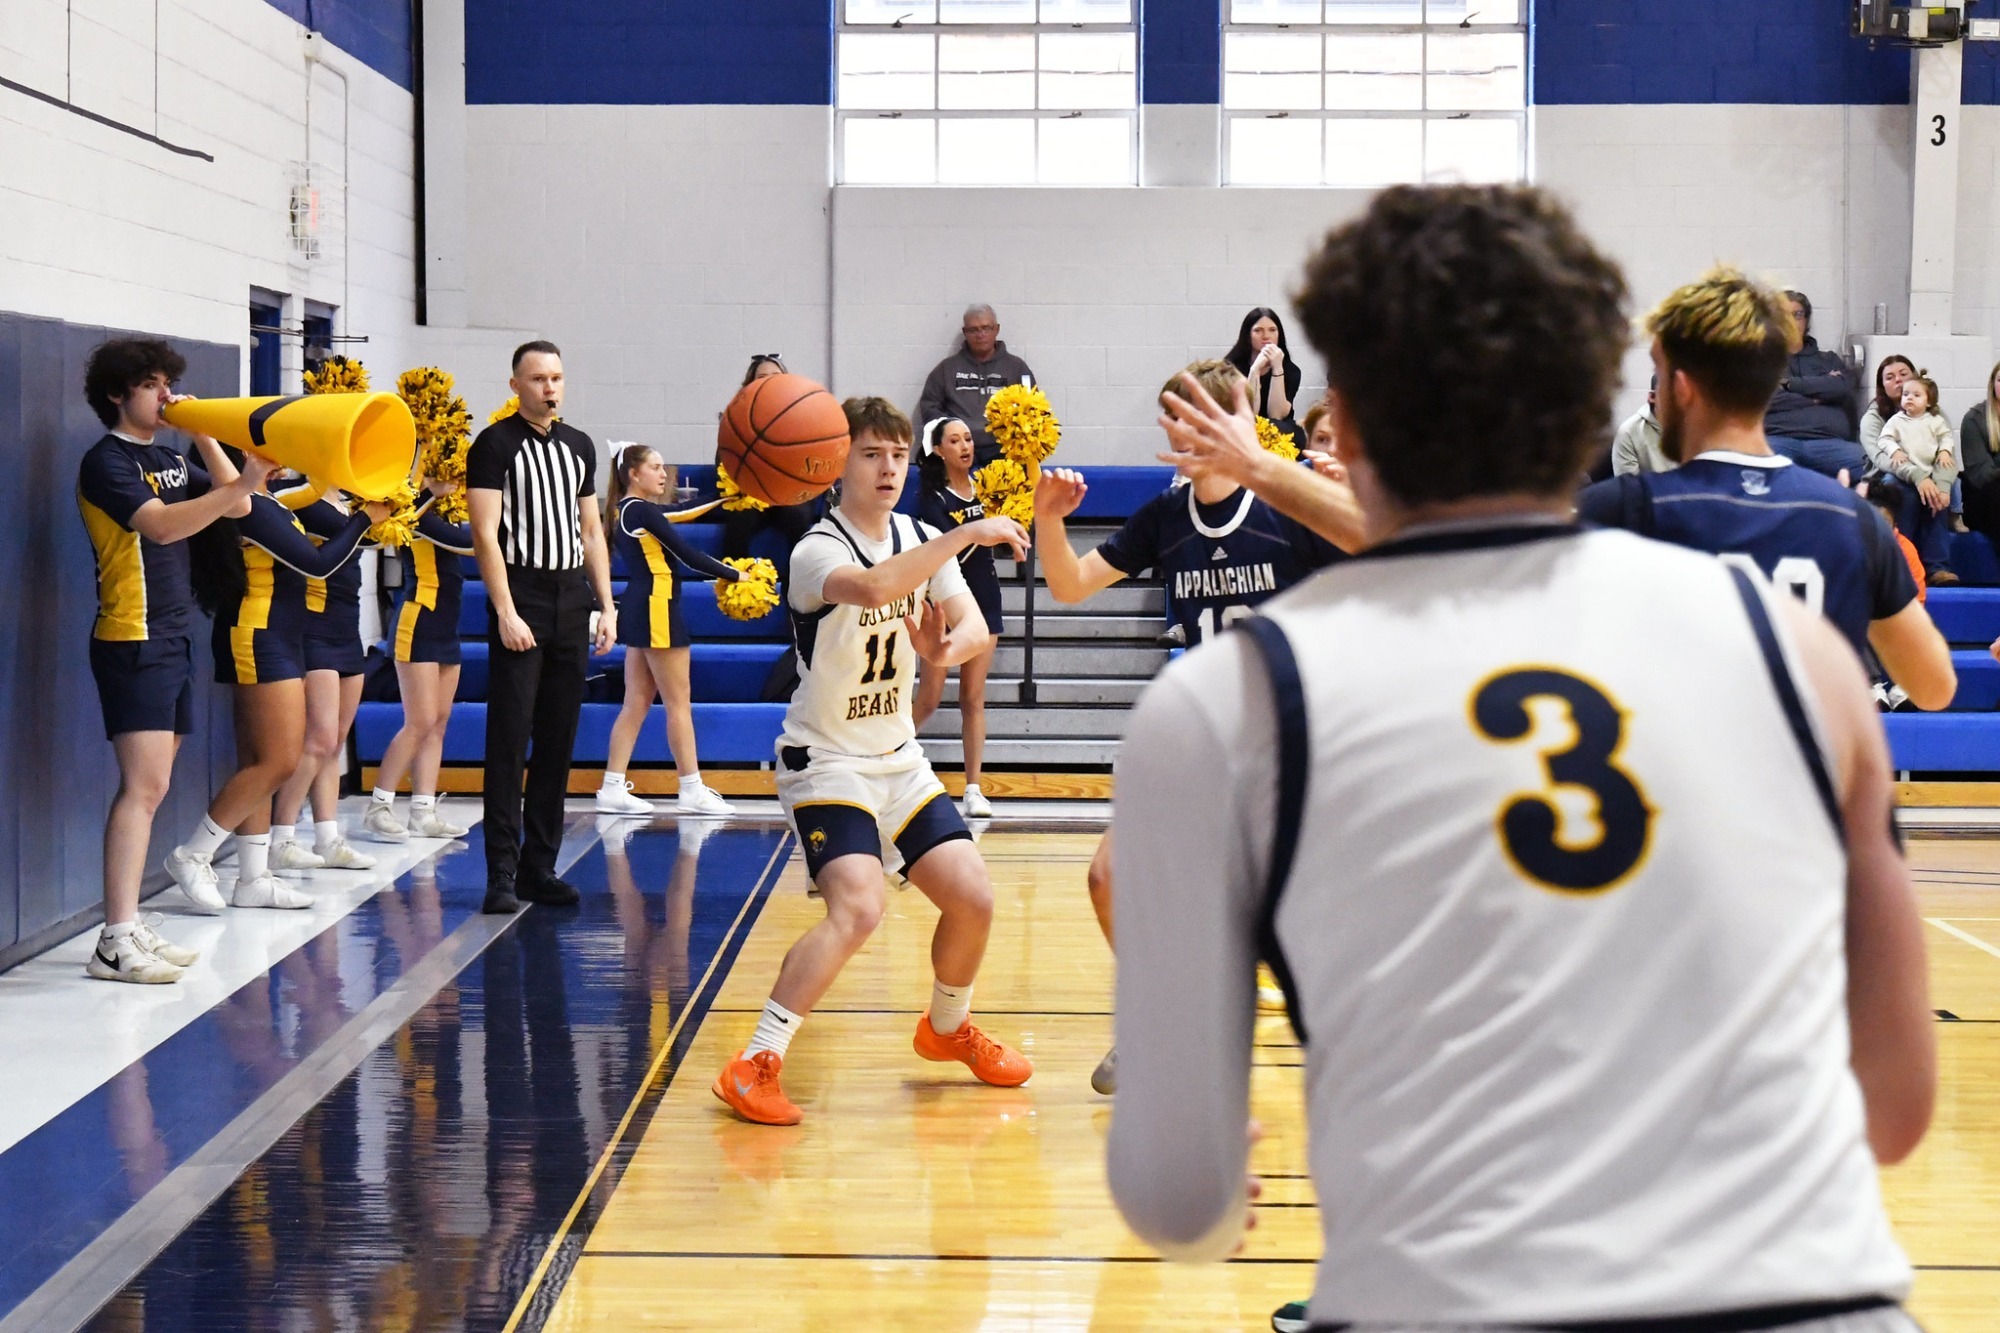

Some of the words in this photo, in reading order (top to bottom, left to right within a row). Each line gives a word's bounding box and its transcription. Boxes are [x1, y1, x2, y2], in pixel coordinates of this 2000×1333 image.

[1931, 114, 1946, 146] 3
[153, 467, 187, 490] TECH
[965, 503, 985, 518] TEC
[1175, 562, 1276, 599] APPALACHIAN
[860, 630, 898, 684] 11
[1465, 661, 1662, 898] 3
